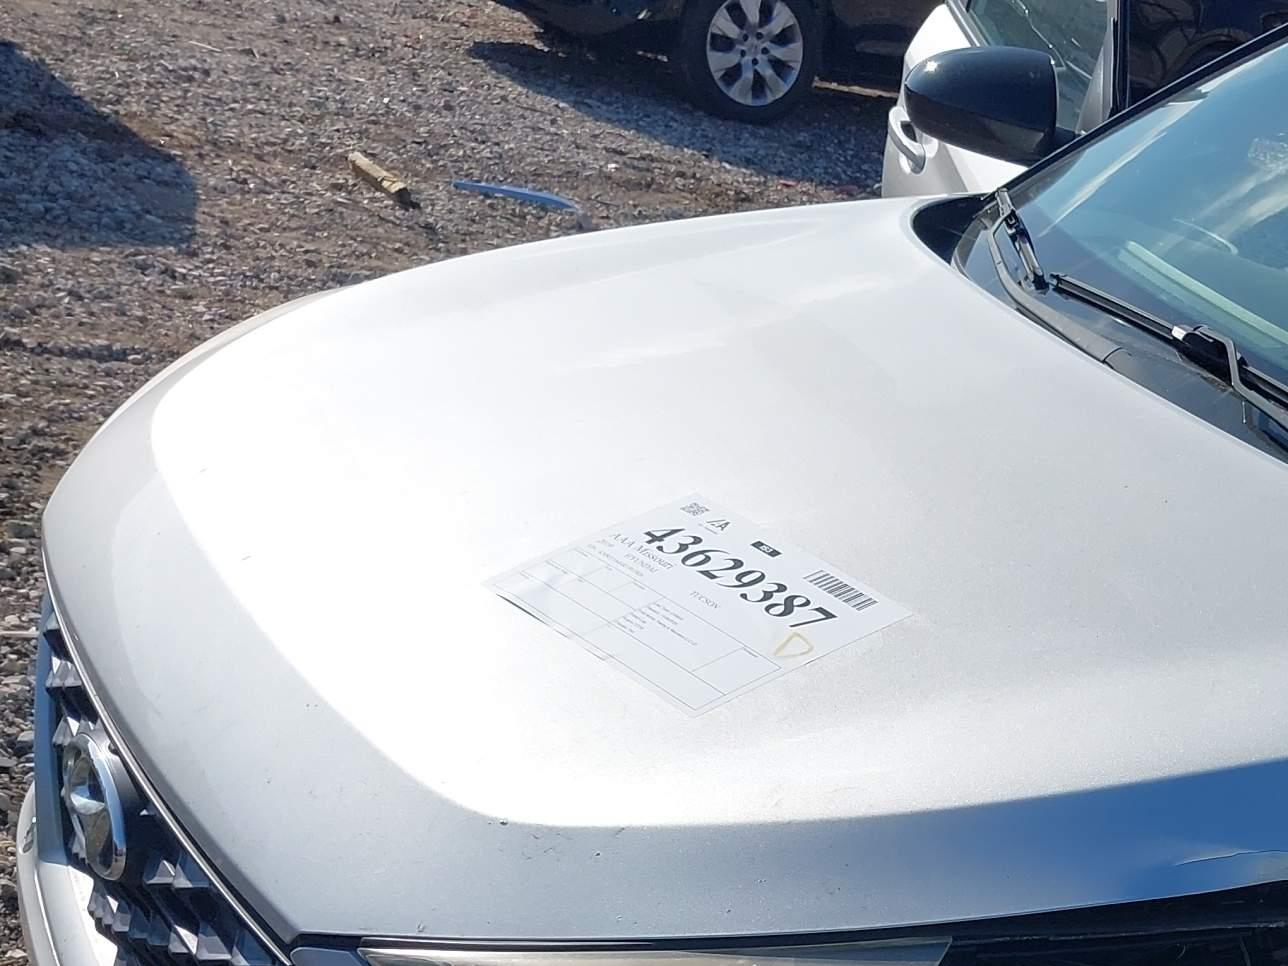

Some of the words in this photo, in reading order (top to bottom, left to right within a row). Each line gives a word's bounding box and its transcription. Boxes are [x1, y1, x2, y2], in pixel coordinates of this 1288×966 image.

[608, 533, 636, 548] AAA
[635, 545, 674, 570] Missouri
[643, 528, 838, 628] 43629387
